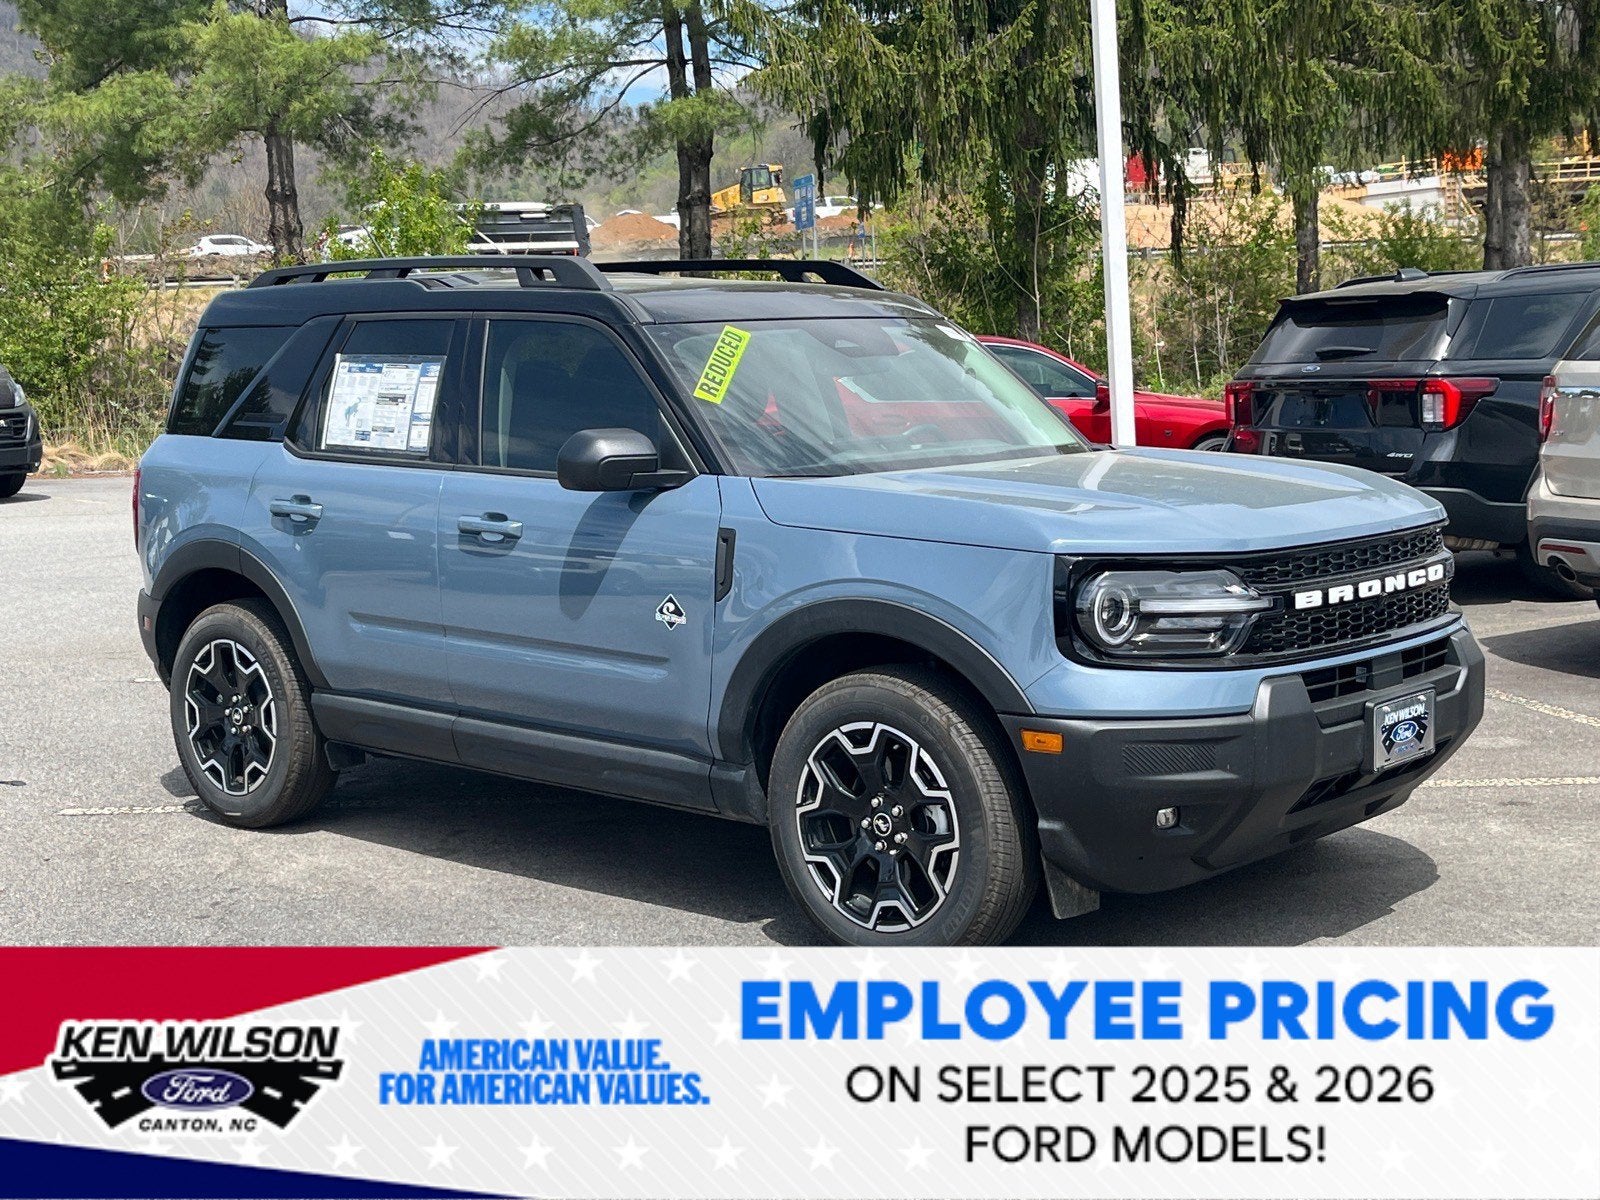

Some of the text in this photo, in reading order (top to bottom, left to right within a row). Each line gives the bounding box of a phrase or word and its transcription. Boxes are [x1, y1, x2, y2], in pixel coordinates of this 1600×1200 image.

[698, 330, 743, 398] REDUCED
[1294, 563, 1445, 610] BRONCO
[1384, 703, 1426, 726] KEN WILSON
[1394, 722, 1416, 741] Ford
